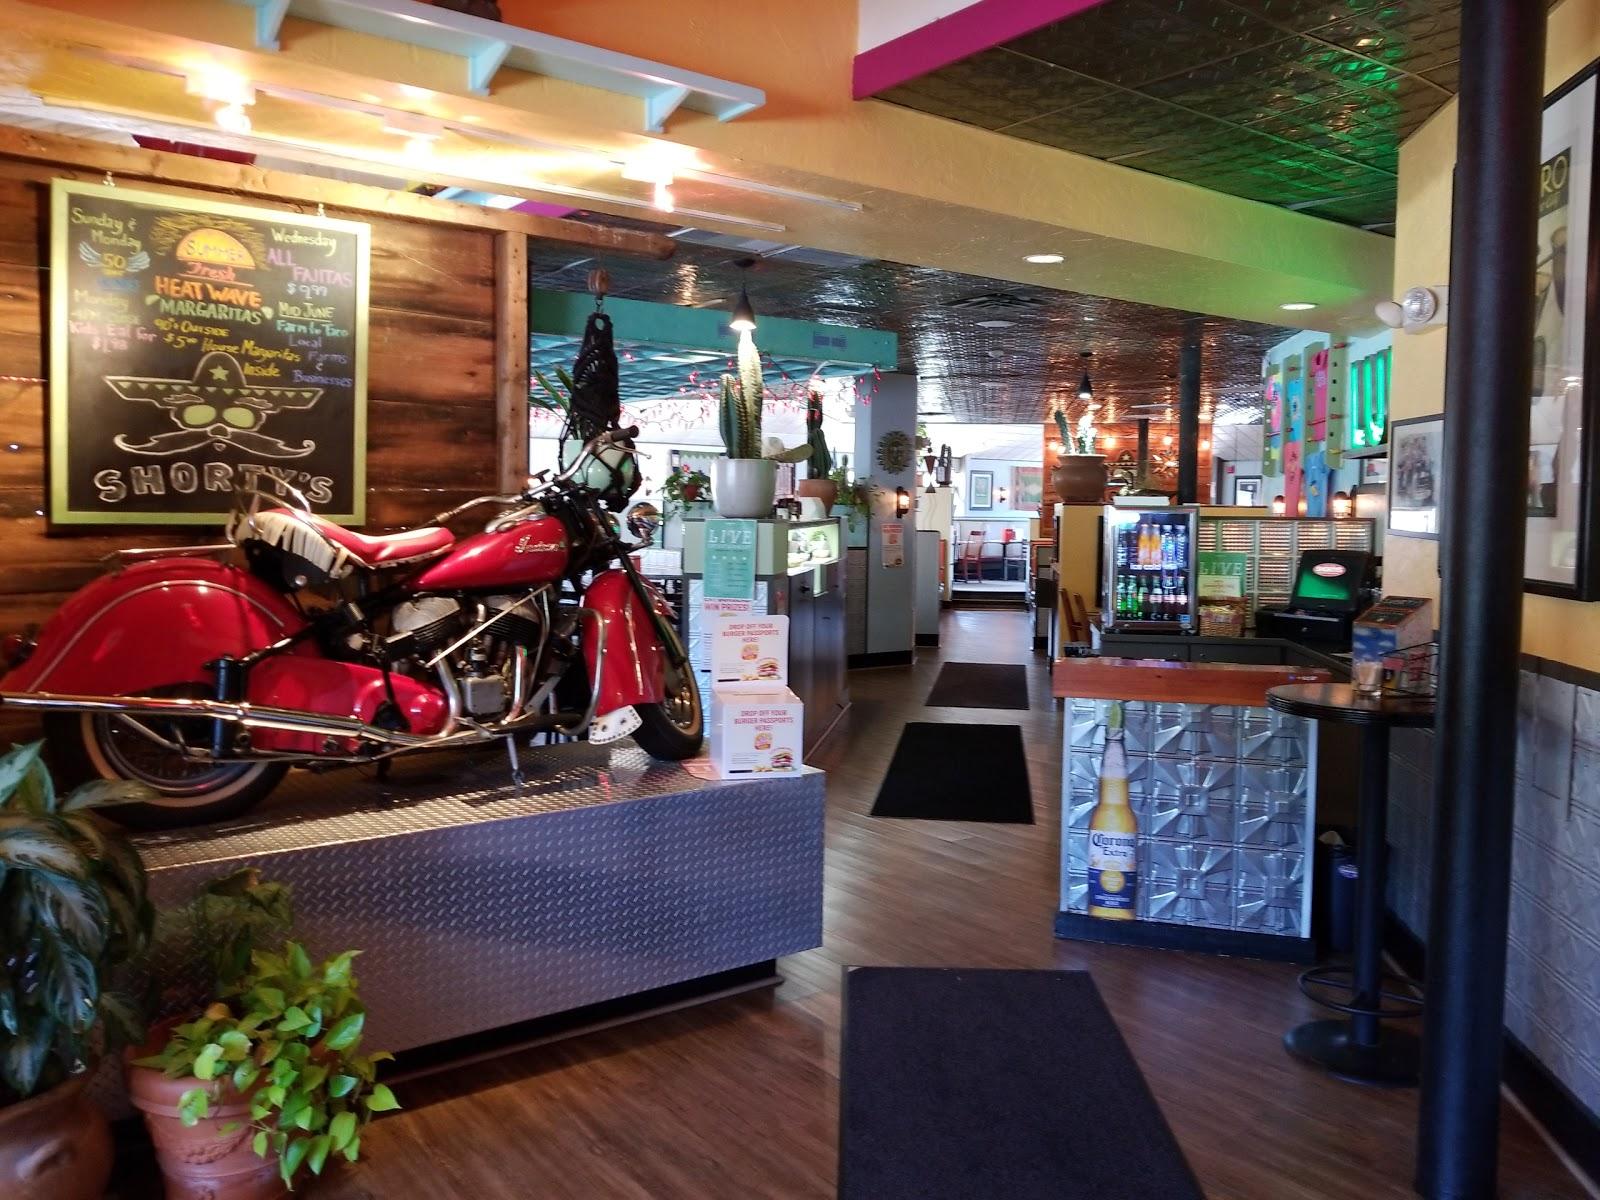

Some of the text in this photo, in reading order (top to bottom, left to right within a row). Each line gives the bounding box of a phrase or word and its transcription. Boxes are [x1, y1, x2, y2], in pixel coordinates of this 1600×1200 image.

[71, 207, 123, 235] Sunday
[91, 229, 142, 255] Monday
[270, 226, 337, 257] Wednesday
[267, 247, 297, 267] ALL
[293, 265, 353, 289] FAJITAS
[154, 275, 203, 300] HEAT
[203, 281, 263, 309] WAVE
[159, 297, 263, 325] MARGARITAS
[289, 333, 322, 348] Local
[93, 461, 334, 503] SHORTY'S
[708, 529, 752, 545] LIVE
[1200, 562, 1242, 575] LIVE
[1092, 833, 1135, 848] Corona
